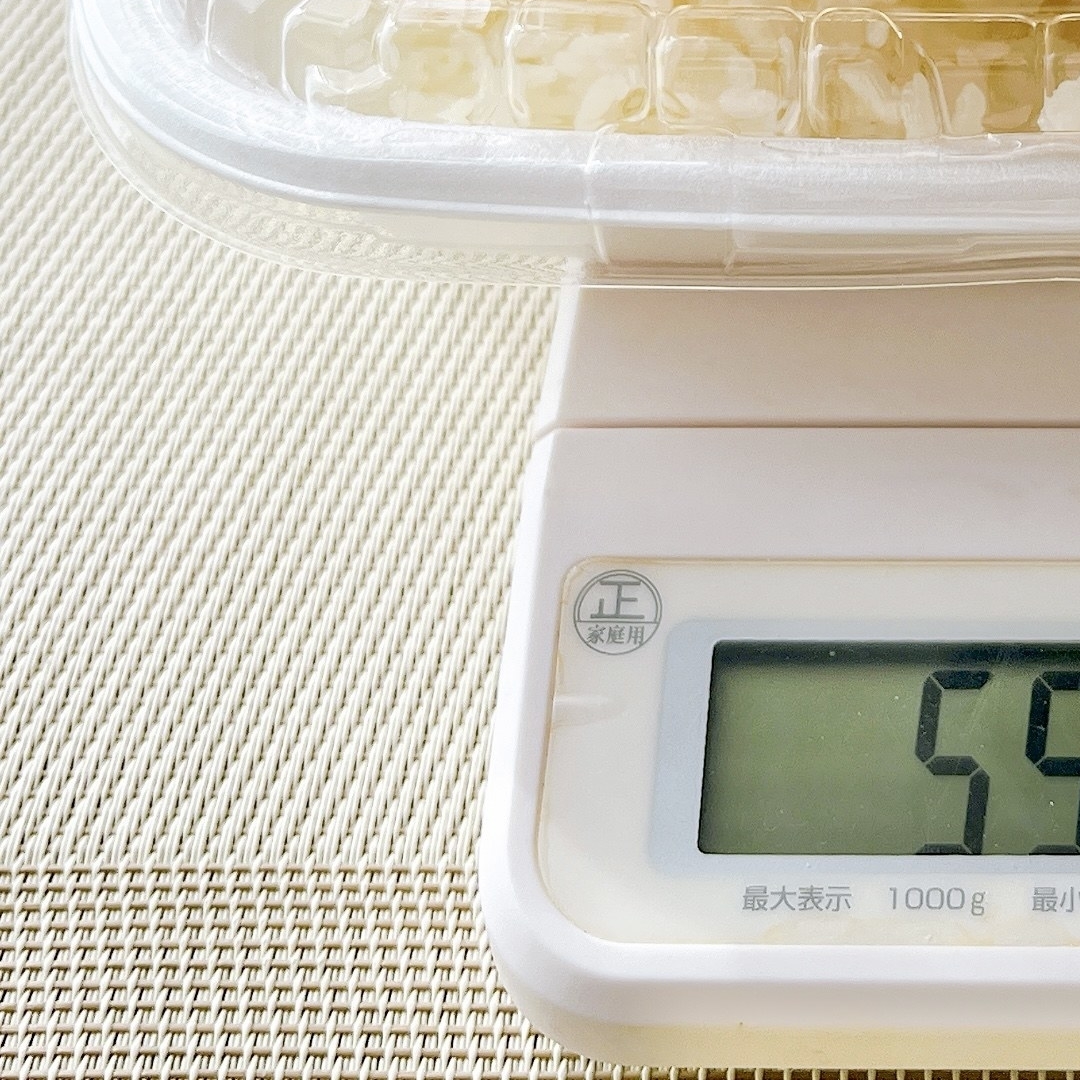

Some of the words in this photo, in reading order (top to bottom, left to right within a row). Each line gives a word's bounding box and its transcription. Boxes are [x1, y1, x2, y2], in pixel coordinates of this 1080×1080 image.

[590, 580, 645, 619] 正
[586, 624, 646, 645] 家庭用
[741, 885, 853, 913] 最大表示
[889, 886, 986, 917] 1000g
